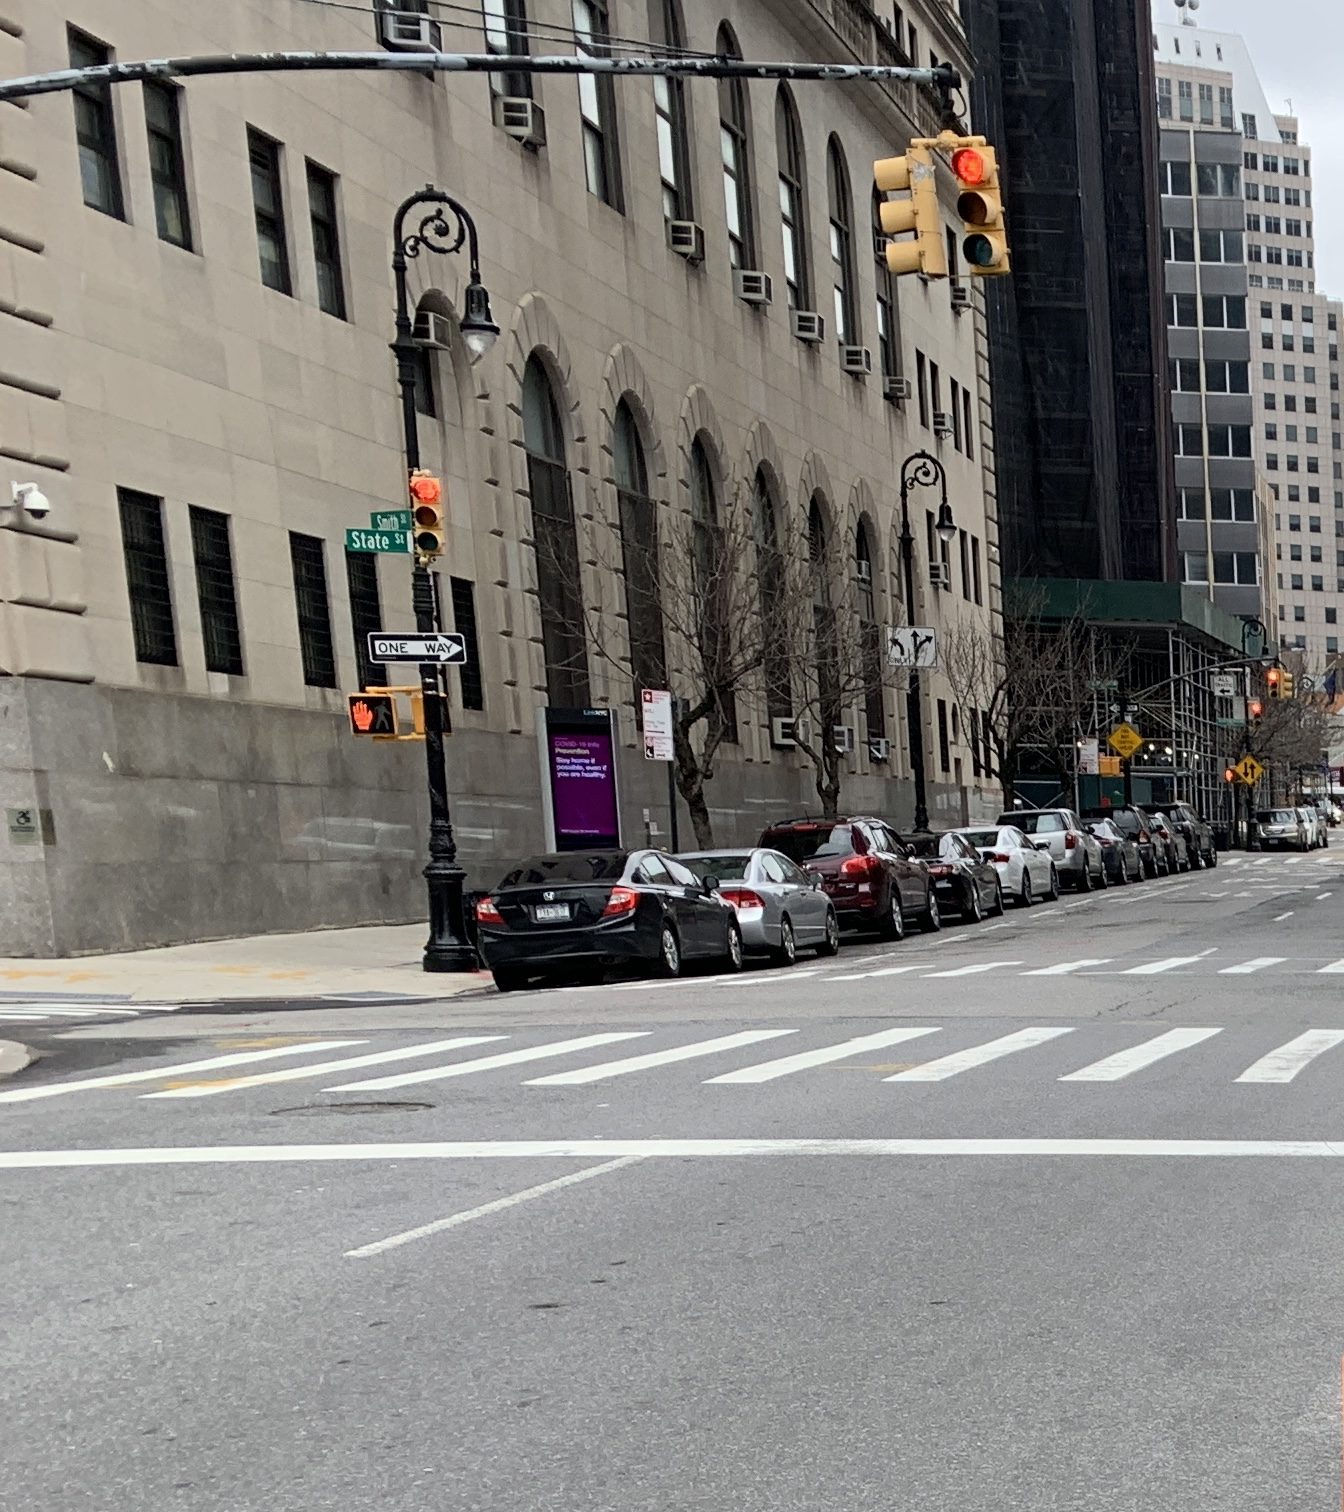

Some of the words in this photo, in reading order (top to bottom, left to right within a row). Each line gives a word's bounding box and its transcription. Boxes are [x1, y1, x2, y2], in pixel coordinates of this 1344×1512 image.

[376, 514, 400, 530] Smith
[400, 513, 407, 524] St
[351, 530, 390, 549] State
[395, 533, 405, 545] St
[378, 642, 408, 653] ONE
[424, 643, 453, 654] WAY
[554, 747, 590, 755] Prevention
[556, 756, 570, 765] Stay
